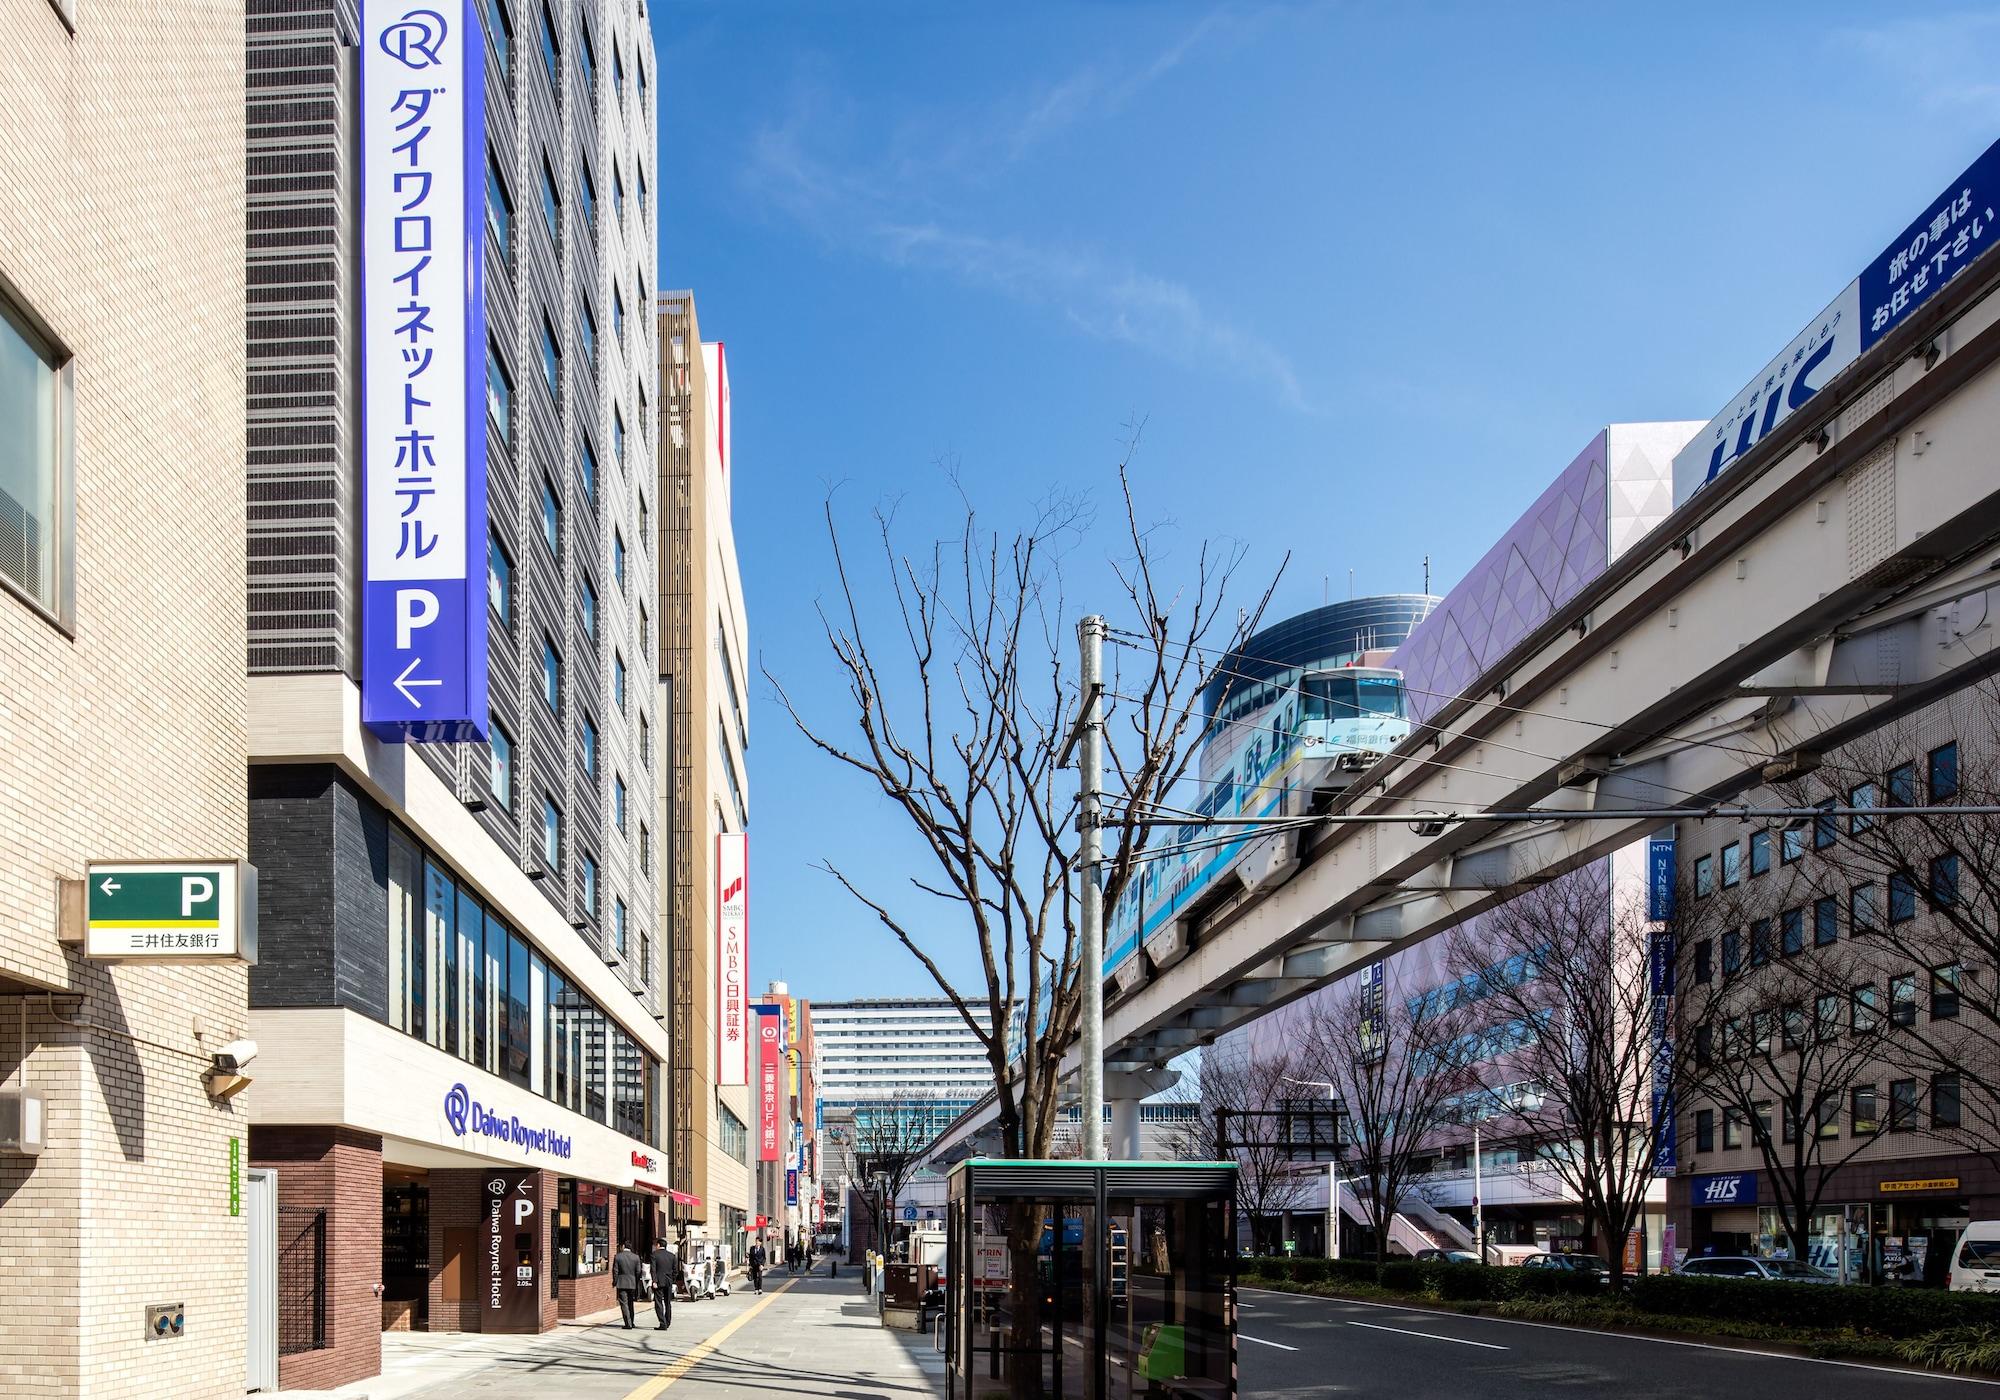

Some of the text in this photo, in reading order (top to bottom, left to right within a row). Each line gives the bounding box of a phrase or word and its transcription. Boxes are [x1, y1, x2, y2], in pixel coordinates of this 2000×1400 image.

[1871, 206, 1995, 332] お任せ下さい
[1888, 187, 1972, 285] 旅の事は
[390, 86, 446, 560] ダイワロイネットホテル
[1715, 310, 1842, 441] もっと世界を楽しもう
[395, 588, 440, 650] P
[1652, 844, 1673, 852] NTN
[181, 876, 214, 917] P
[130, 933, 220, 948] 三井住友銀行
[726, 926, 741, 1042] SMBC日興証券
[471, 1100, 571, 1159] Daiwa Roynet Hotel
[764, 1063, 775, 1150] 三菱東京UFJ銀行
[515, 1199, 534, 1225] P
[1704, 1179, 1741, 1200] HIS
[488, 1199, 502, 1309] Daiwa Roynet Hotel
